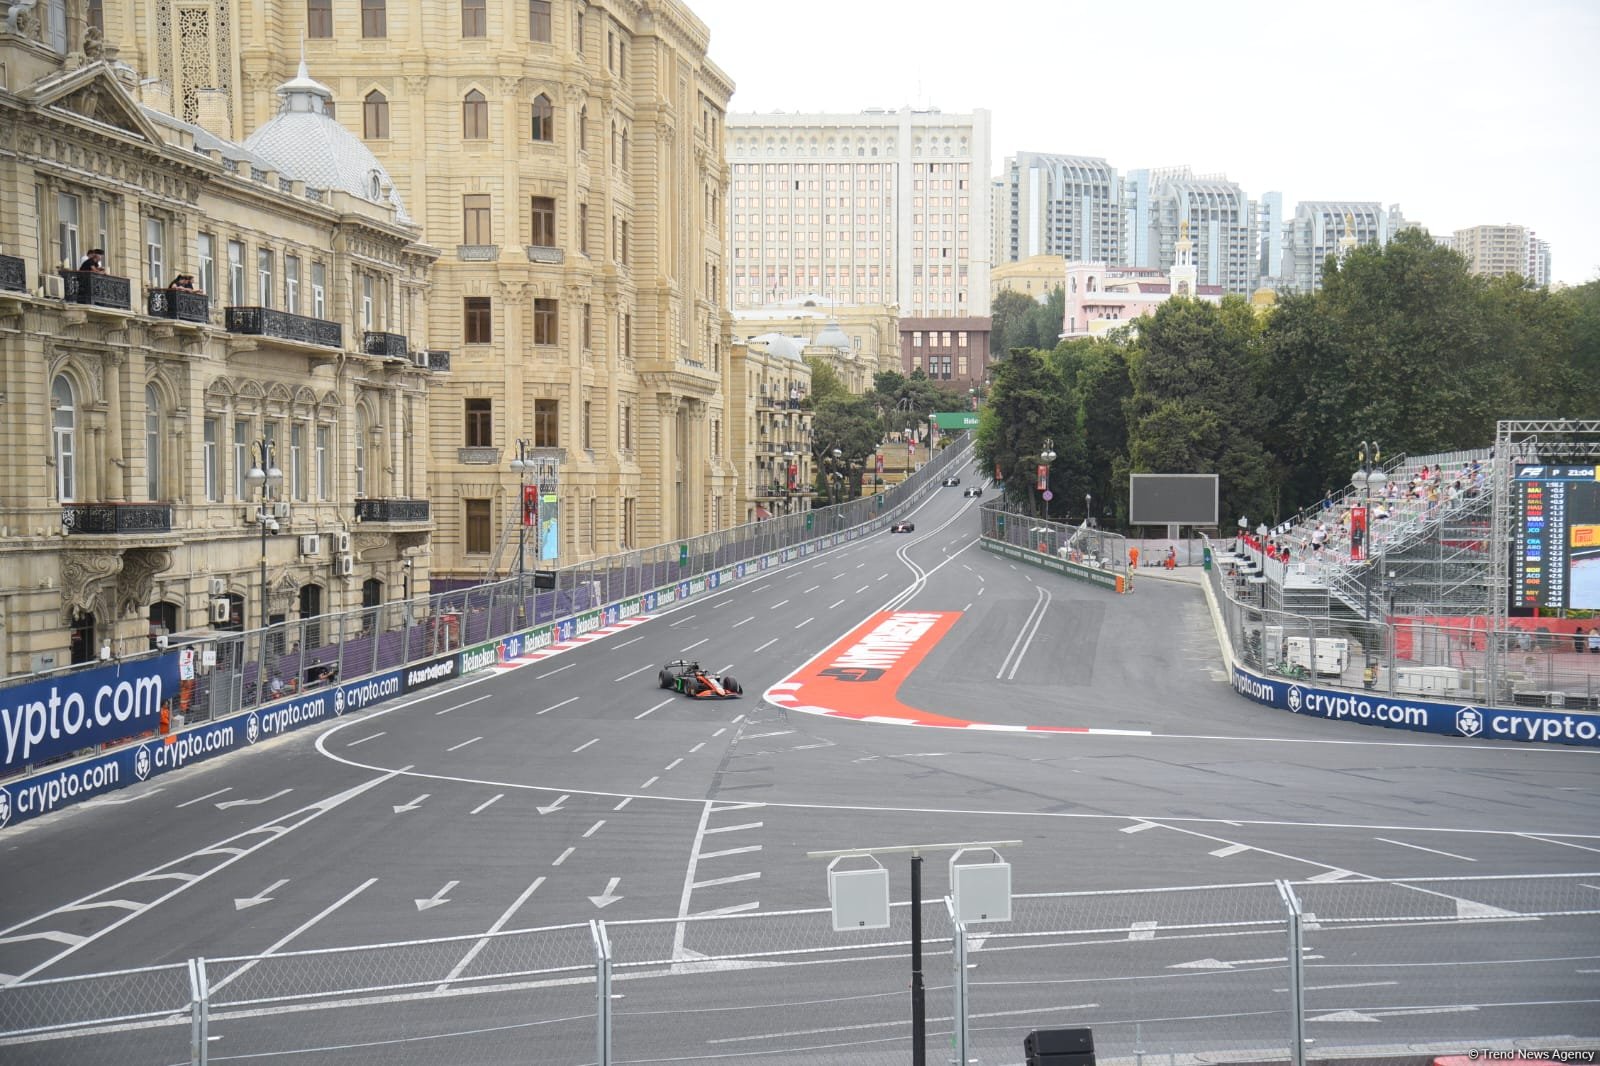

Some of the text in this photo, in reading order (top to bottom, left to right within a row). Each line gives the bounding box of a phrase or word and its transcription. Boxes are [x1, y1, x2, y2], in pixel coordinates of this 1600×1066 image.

[524, 629, 552, 654] Heineken
[463, 645, 496, 673] Heineken
[347, 677, 399, 707] crypto.com
[1, 674, 162, 764] ypto.com
[262, 698, 325, 734] crypto.com
[1306, 694, 1428, 726] crypto.com
[155, 726, 234, 768] crypto.com
[17, 761, 119, 812] crypto.com
